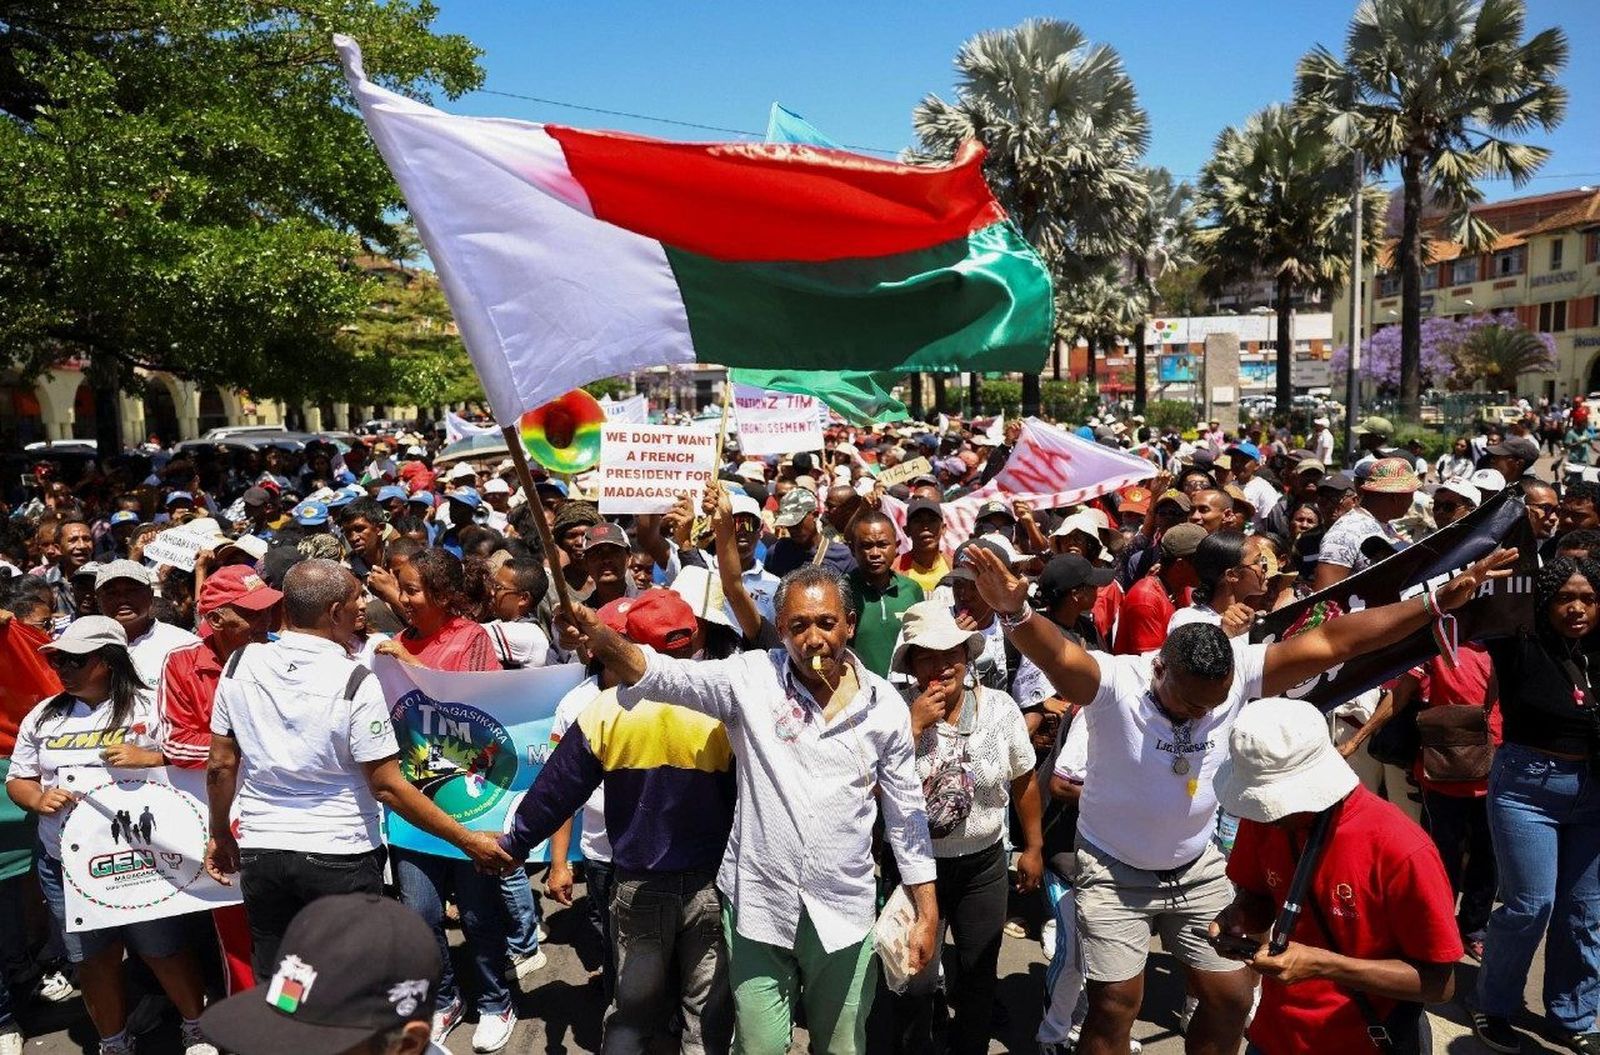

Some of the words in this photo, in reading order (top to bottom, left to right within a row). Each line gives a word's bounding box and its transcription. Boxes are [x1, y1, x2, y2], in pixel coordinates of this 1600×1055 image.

[786, 395, 812, 409] TIM
[606, 432, 627, 443] WE
[632, 433, 673, 444] DON'T
[677, 435, 712, 446] WANT
[626, 451, 636, 461] A
[640, 452, 694, 463] FRENCH
[606, 469, 681, 480] PRESIDENT
[686, 471, 712, 481] FOR
[604, 487, 697, 498] MADAGASCAR
[418, 704, 472, 744] TIM
[89, 849, 156, 878] GEN
[159, 852, 182, 870] Y
